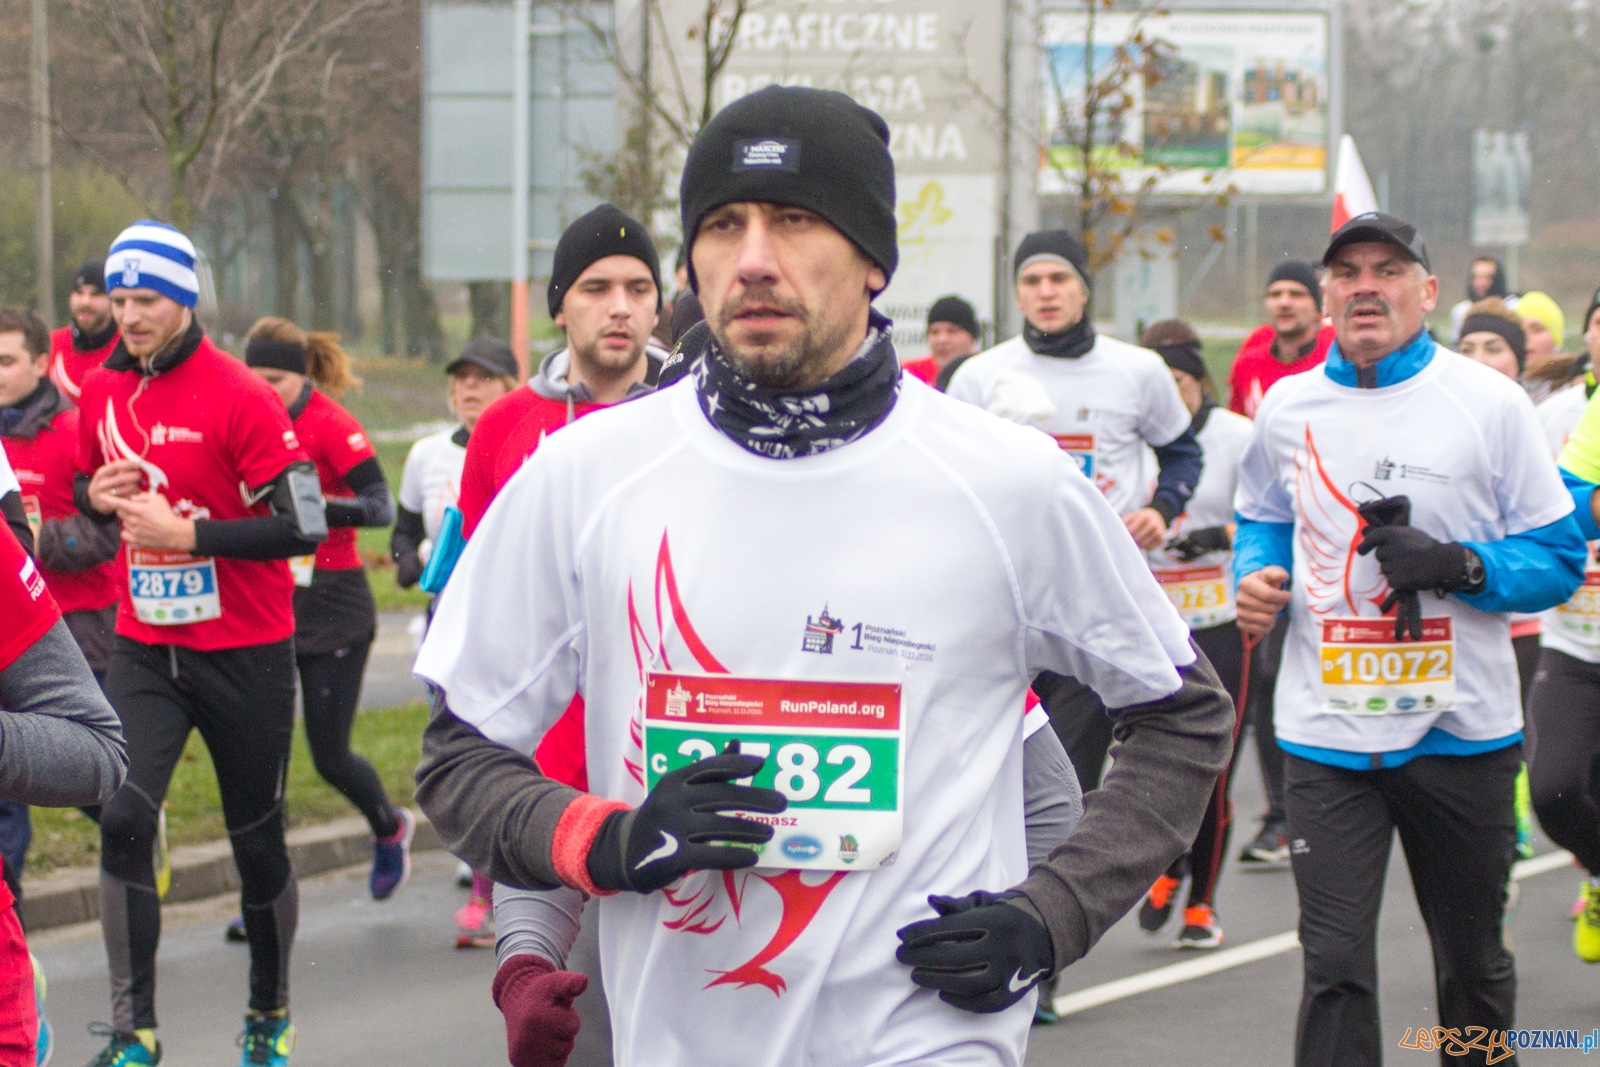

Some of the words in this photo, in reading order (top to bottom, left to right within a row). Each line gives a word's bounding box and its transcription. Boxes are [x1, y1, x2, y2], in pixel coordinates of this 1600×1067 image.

[138, 569, 204, 597] 2879
[850, 622, 863, 650] 1
[865, 624, 907, 637] Poznański
[864, 633, 881, 643] Bieg
[883, 636, 936, 651] Niepodległości
[1336, 649, 1449, 682] 10072
[696, 692, 706, 713] 1
[780, 700, 885, 718] RunPoland.org
